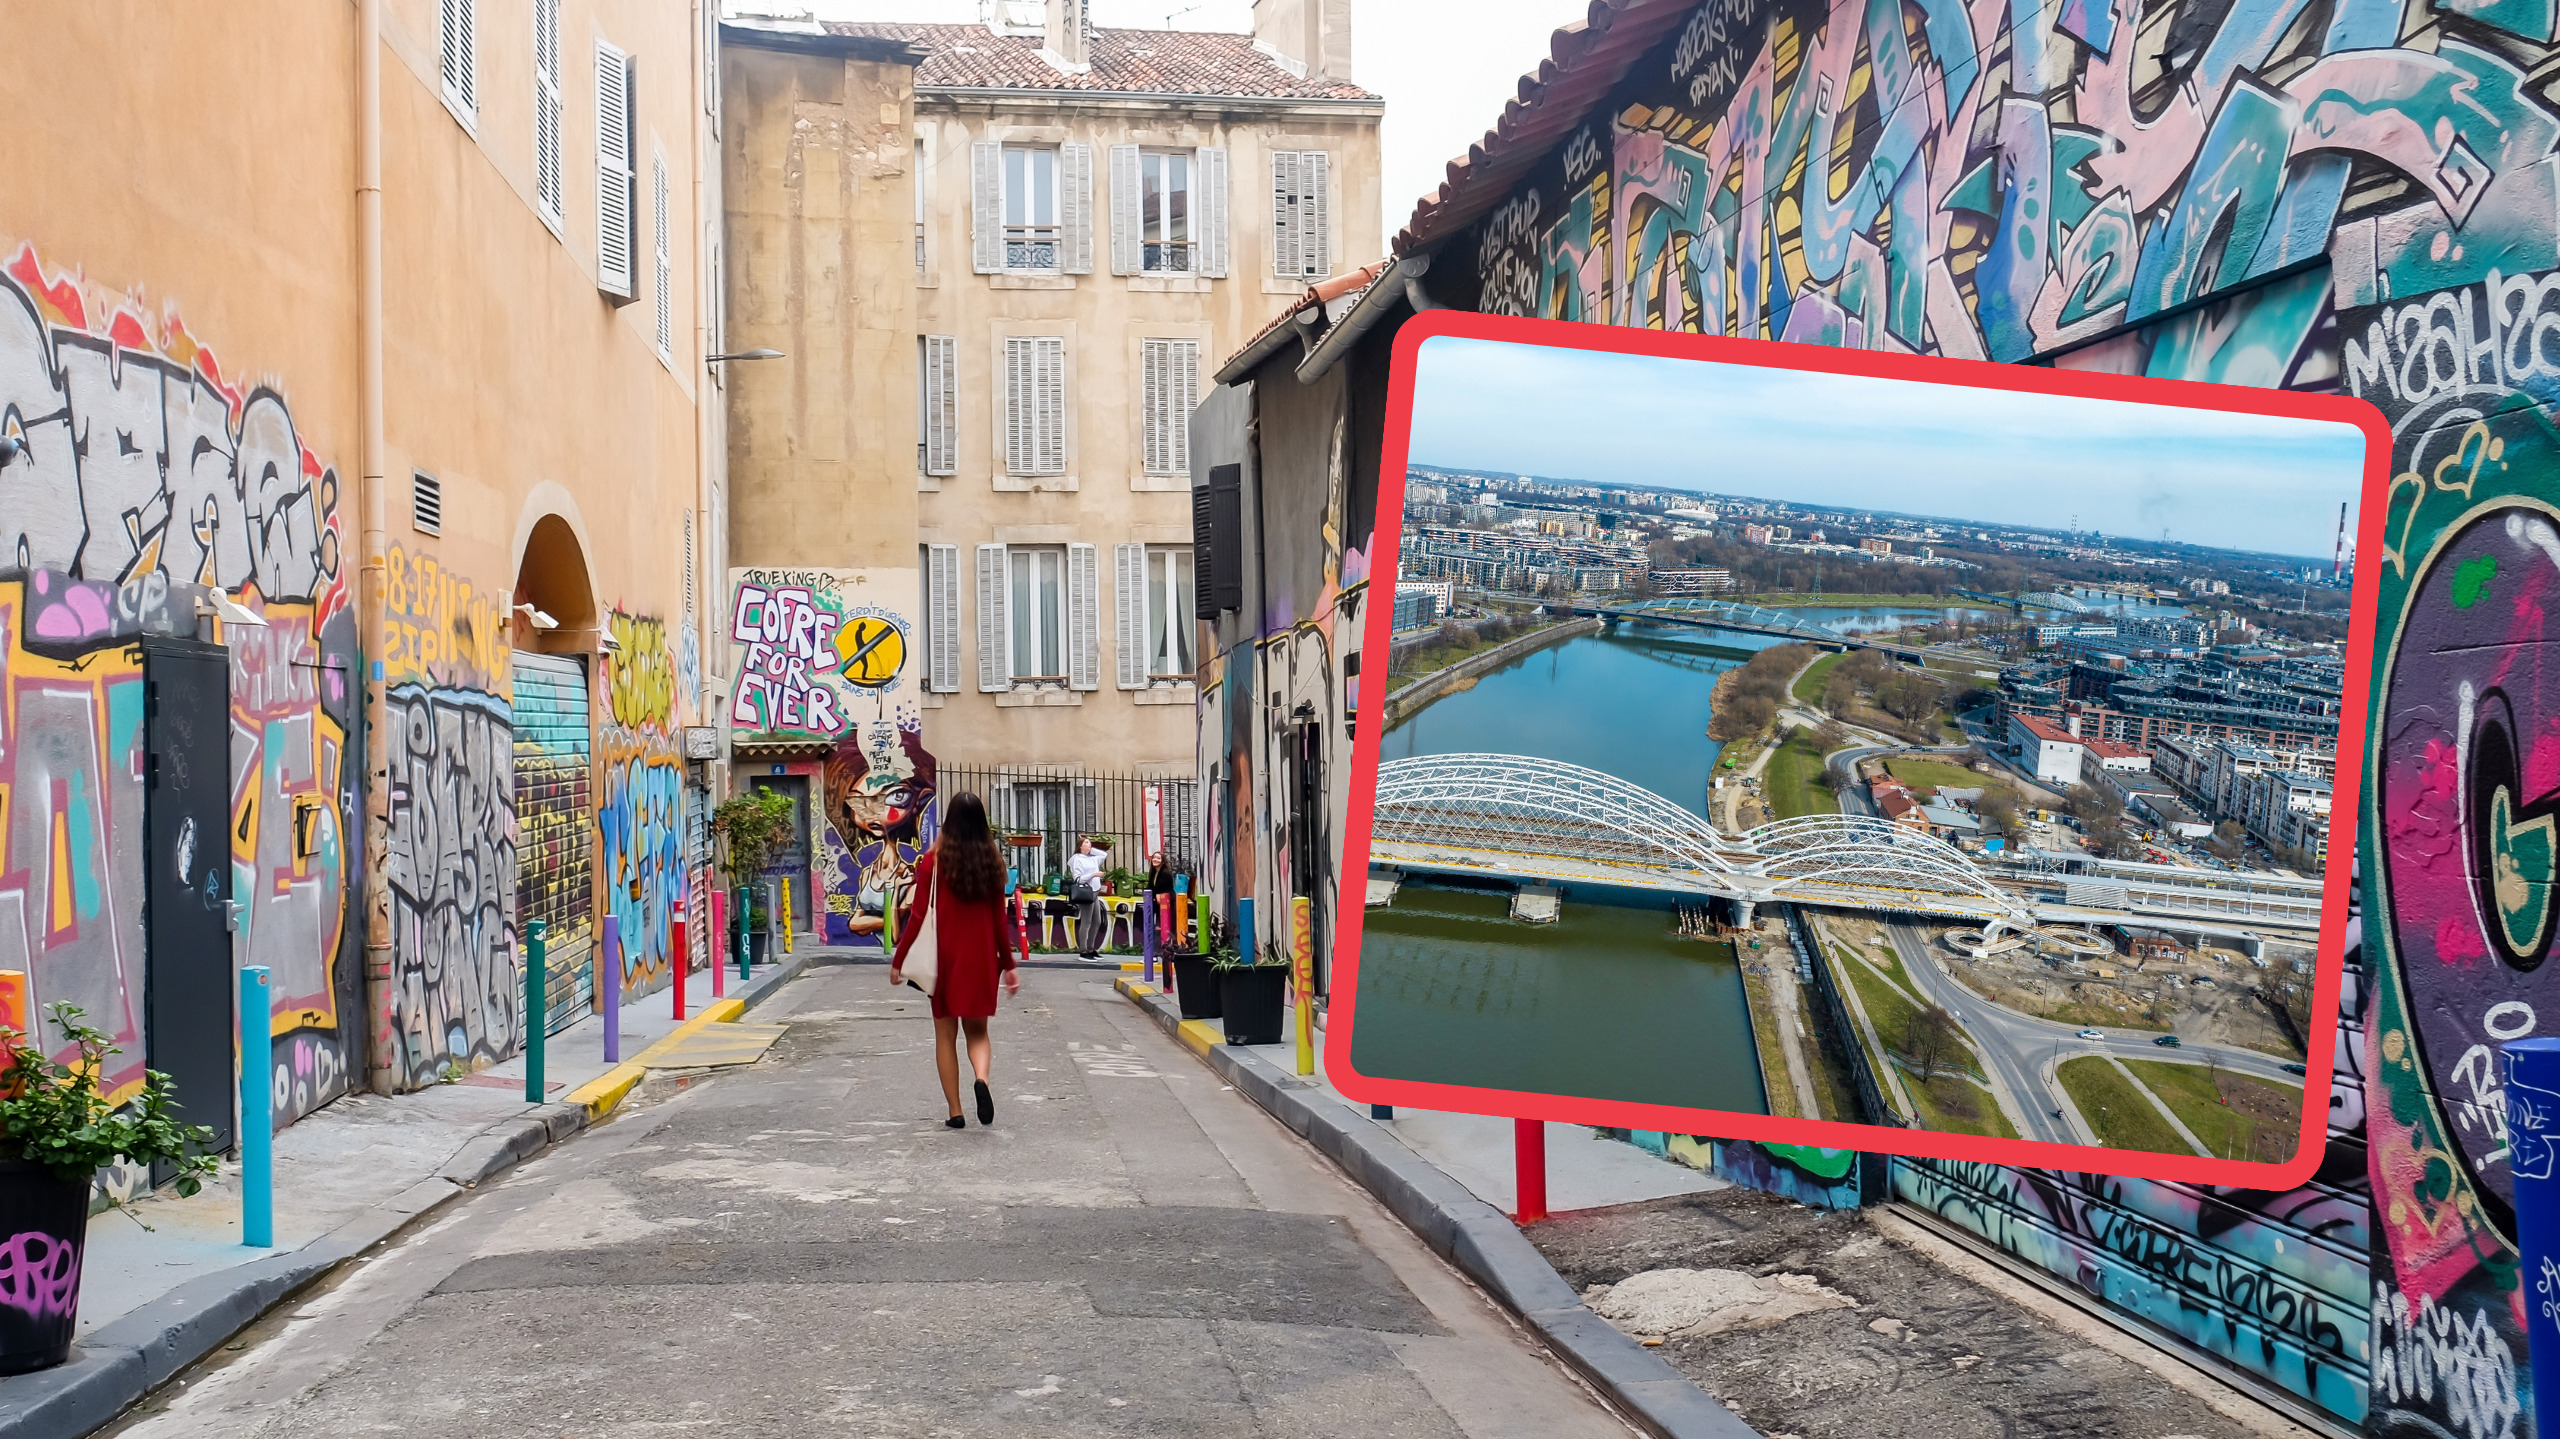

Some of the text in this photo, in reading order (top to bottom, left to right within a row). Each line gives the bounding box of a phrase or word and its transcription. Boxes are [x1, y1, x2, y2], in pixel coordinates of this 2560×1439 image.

[743, 569, 781, 586] TRUE
[735, 587, 838, 669] COFRE
[745, 643, 811, 692] FOR
[841, 677, 901, 698] DANS LA RUE
[734, 672, 842, 731] EVER
